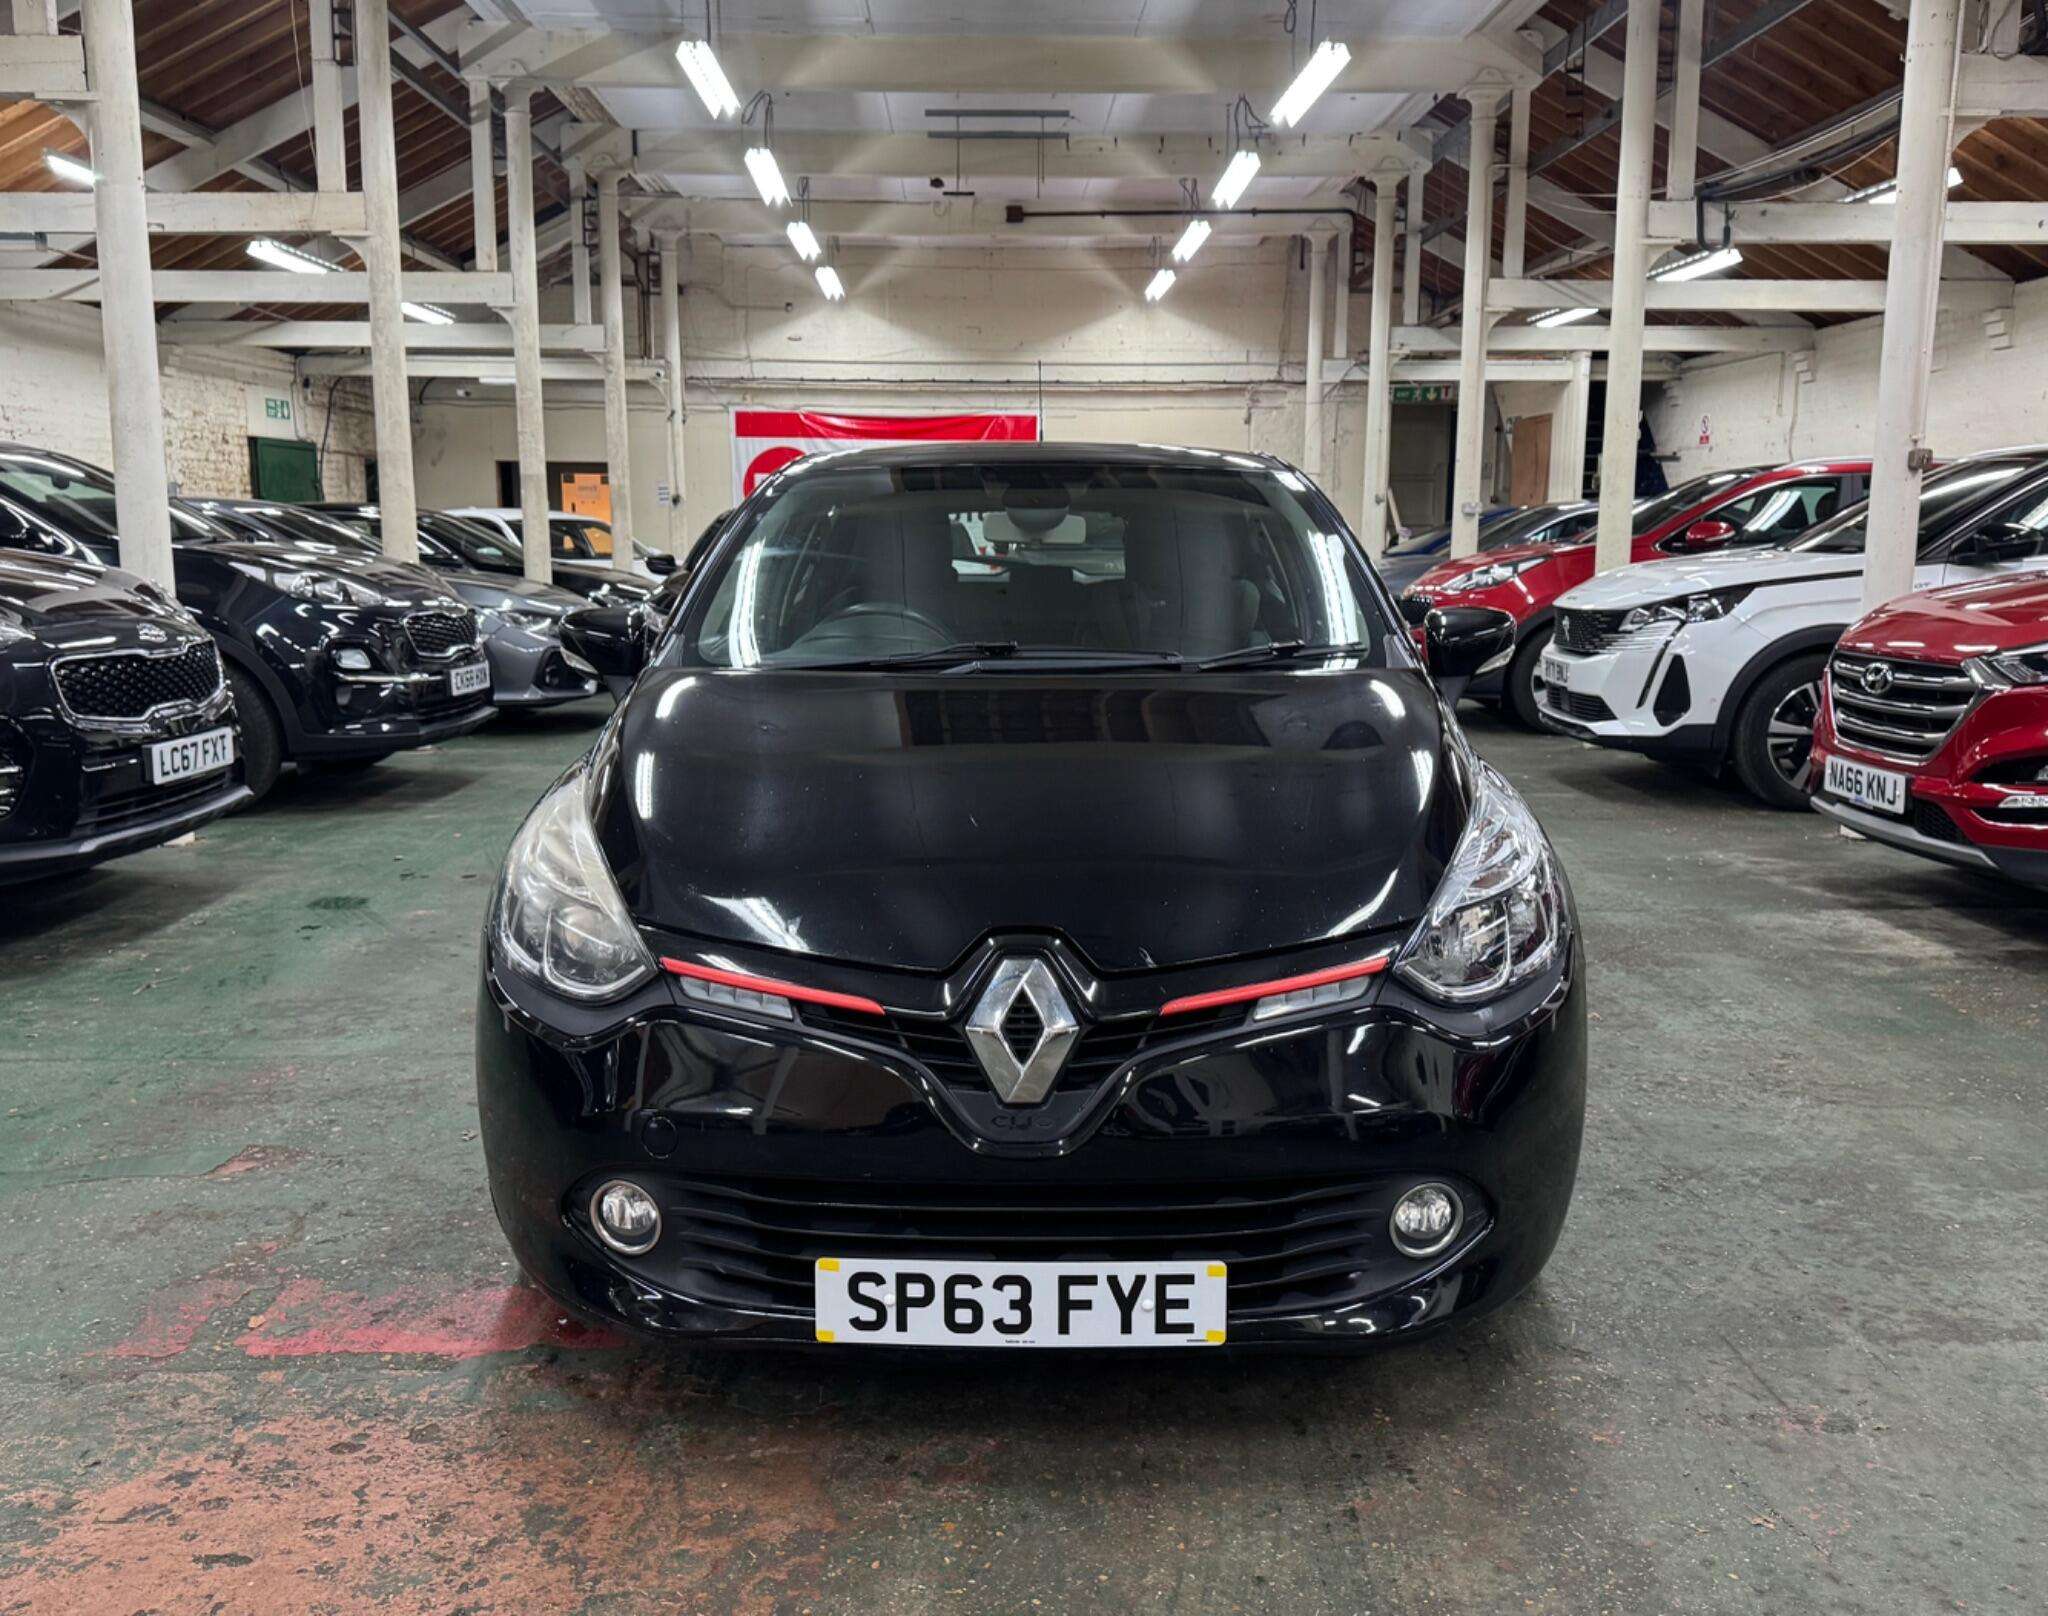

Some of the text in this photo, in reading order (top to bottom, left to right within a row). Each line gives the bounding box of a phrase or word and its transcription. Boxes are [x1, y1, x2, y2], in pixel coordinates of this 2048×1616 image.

[160, 734, 227, 777] LC67 FXT
[1830, 761, 1897, 805] NA66 KNJ
[847, 1271, 1196, 1335] SP63 FYE
